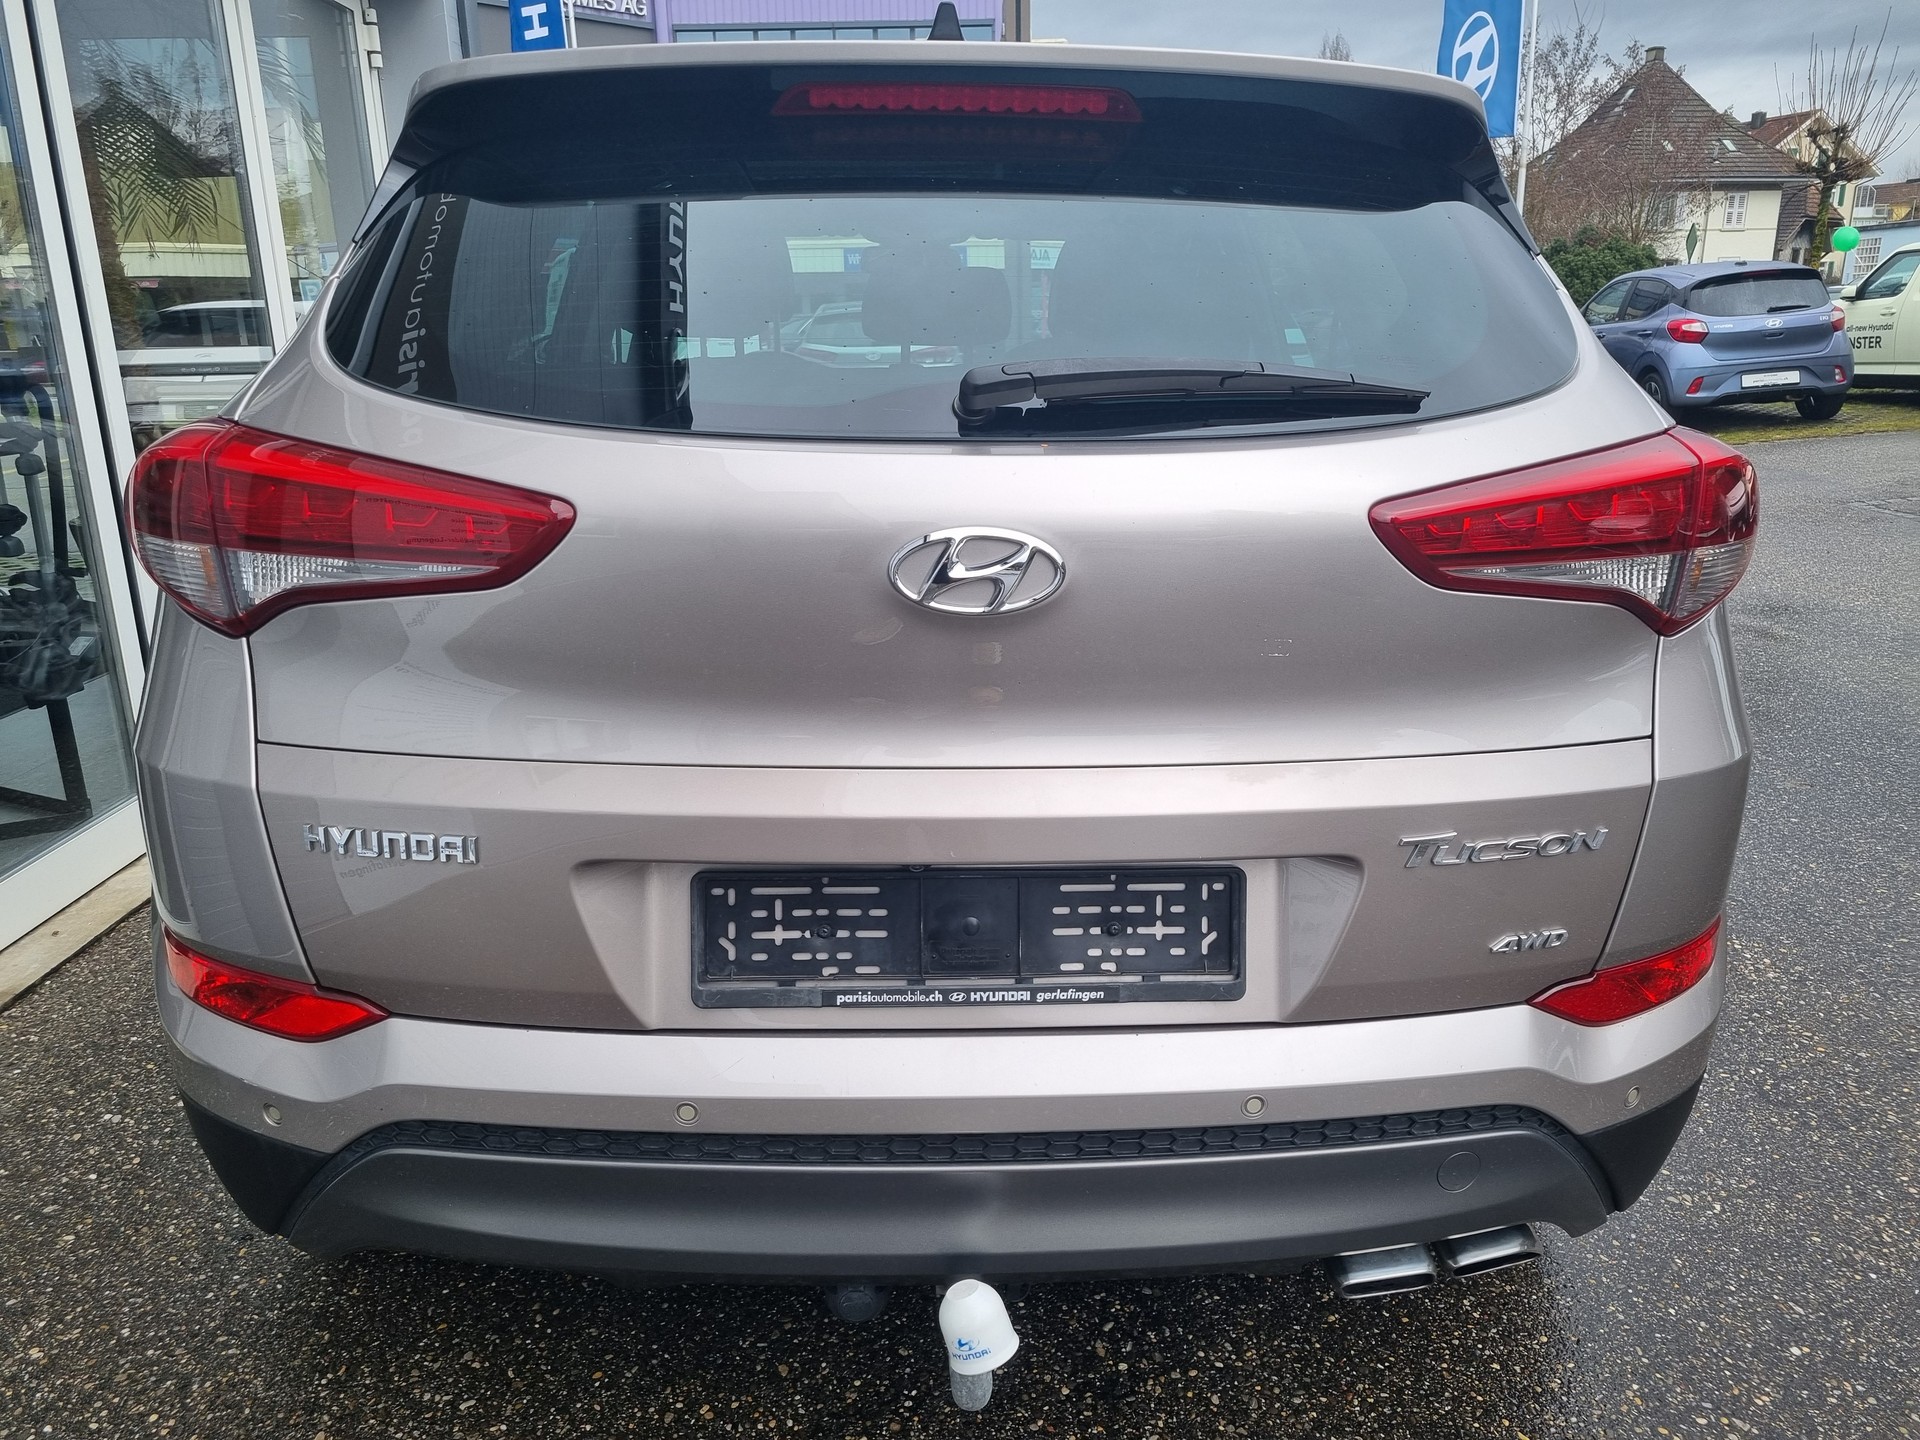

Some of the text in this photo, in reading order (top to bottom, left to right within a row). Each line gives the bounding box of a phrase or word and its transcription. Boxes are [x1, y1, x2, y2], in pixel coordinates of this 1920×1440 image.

[621, 0, 648, 16] AG
[1868, 322, 1894, 332] Hyundai
[303, 823, 480, 865] HYUNDAI
[1398, 826, 1609, 868] TUCSON
[1489, 928, 1569, 953] 4WD
[836, 989, 1105, 1005] parisiautomobile.ch HYUNDAI gerlafingen
[952, 1348, 992, 1360] HYUNDAI
